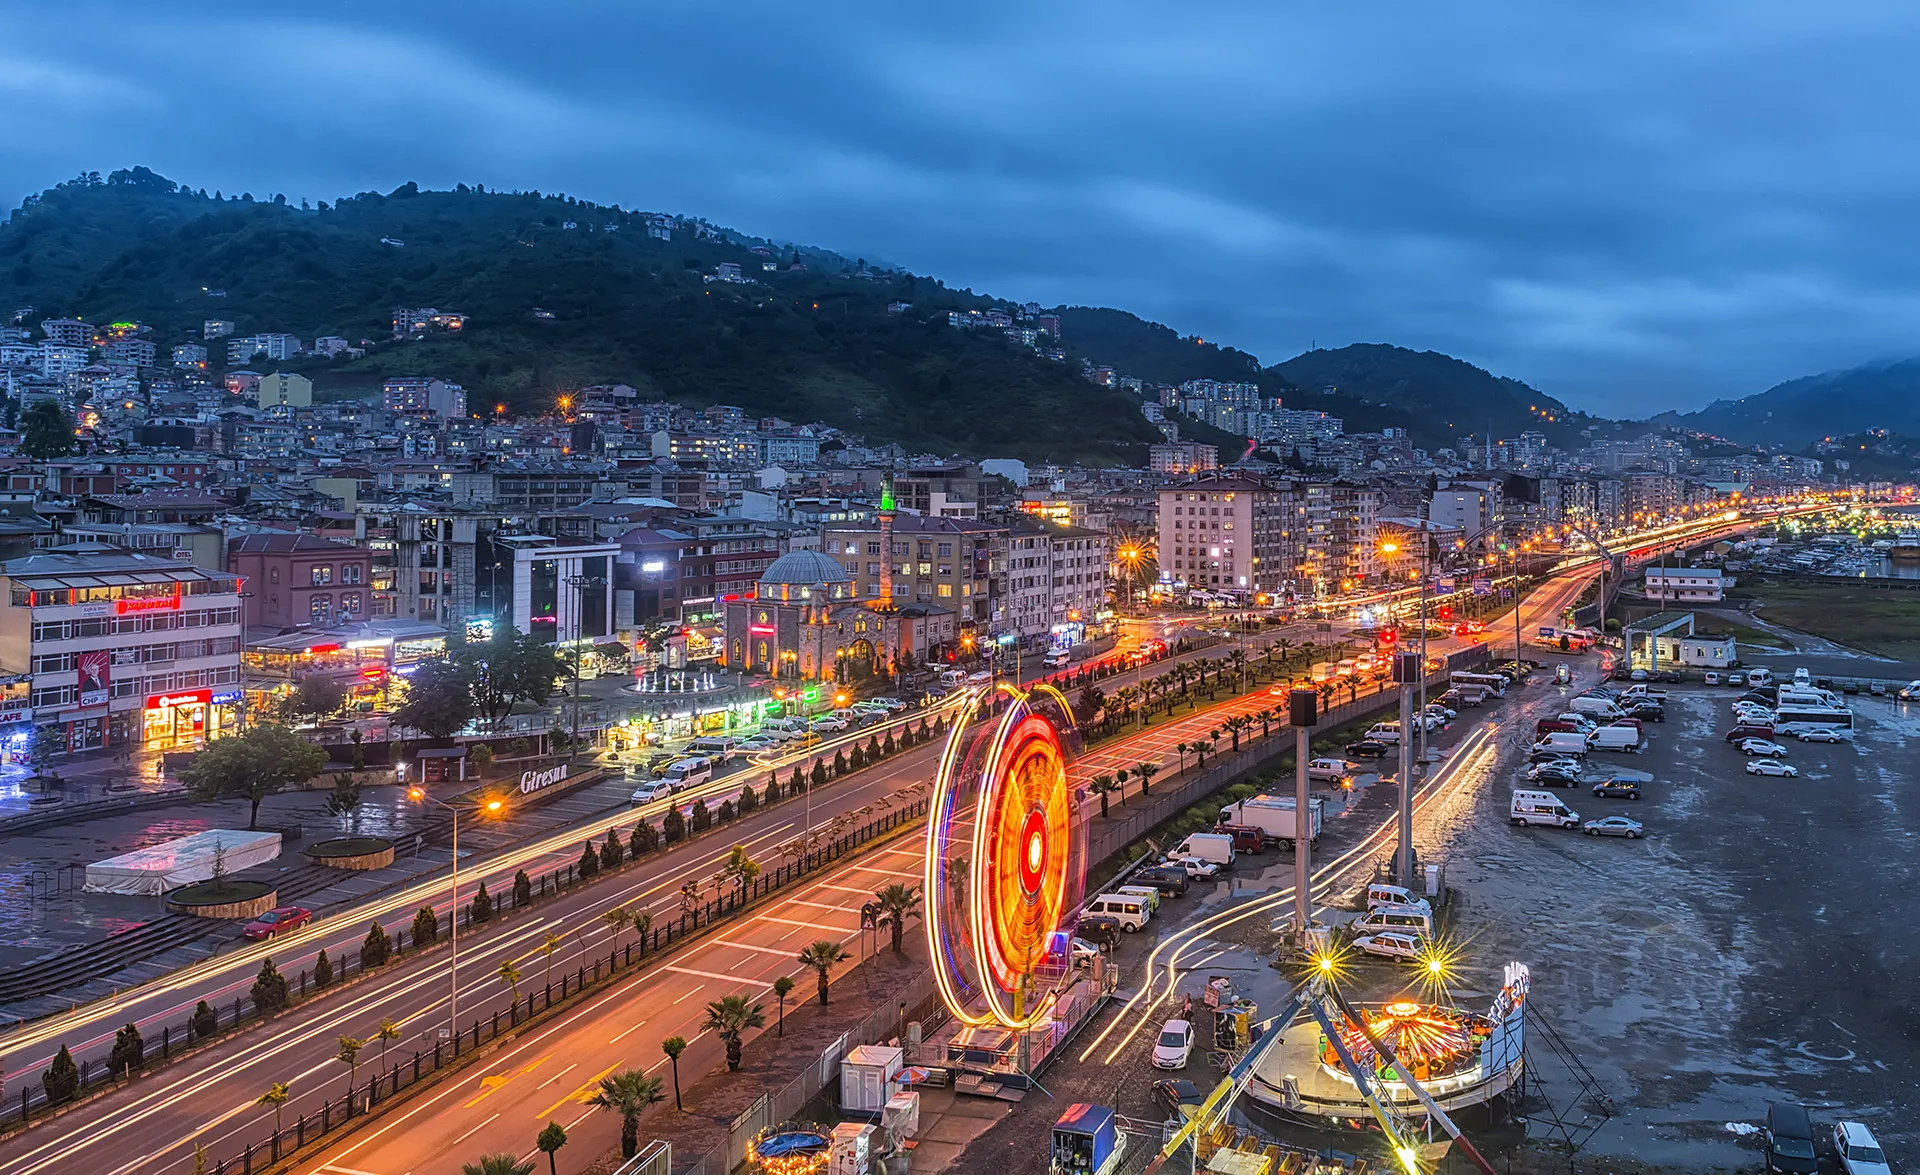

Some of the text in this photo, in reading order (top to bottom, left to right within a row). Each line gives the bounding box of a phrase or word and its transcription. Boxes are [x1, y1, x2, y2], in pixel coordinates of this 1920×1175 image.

[126, 601, 144, 611] Kafe
[82, 697, 99, 705] CHP
[520, 764, 567, 794] Giresun
